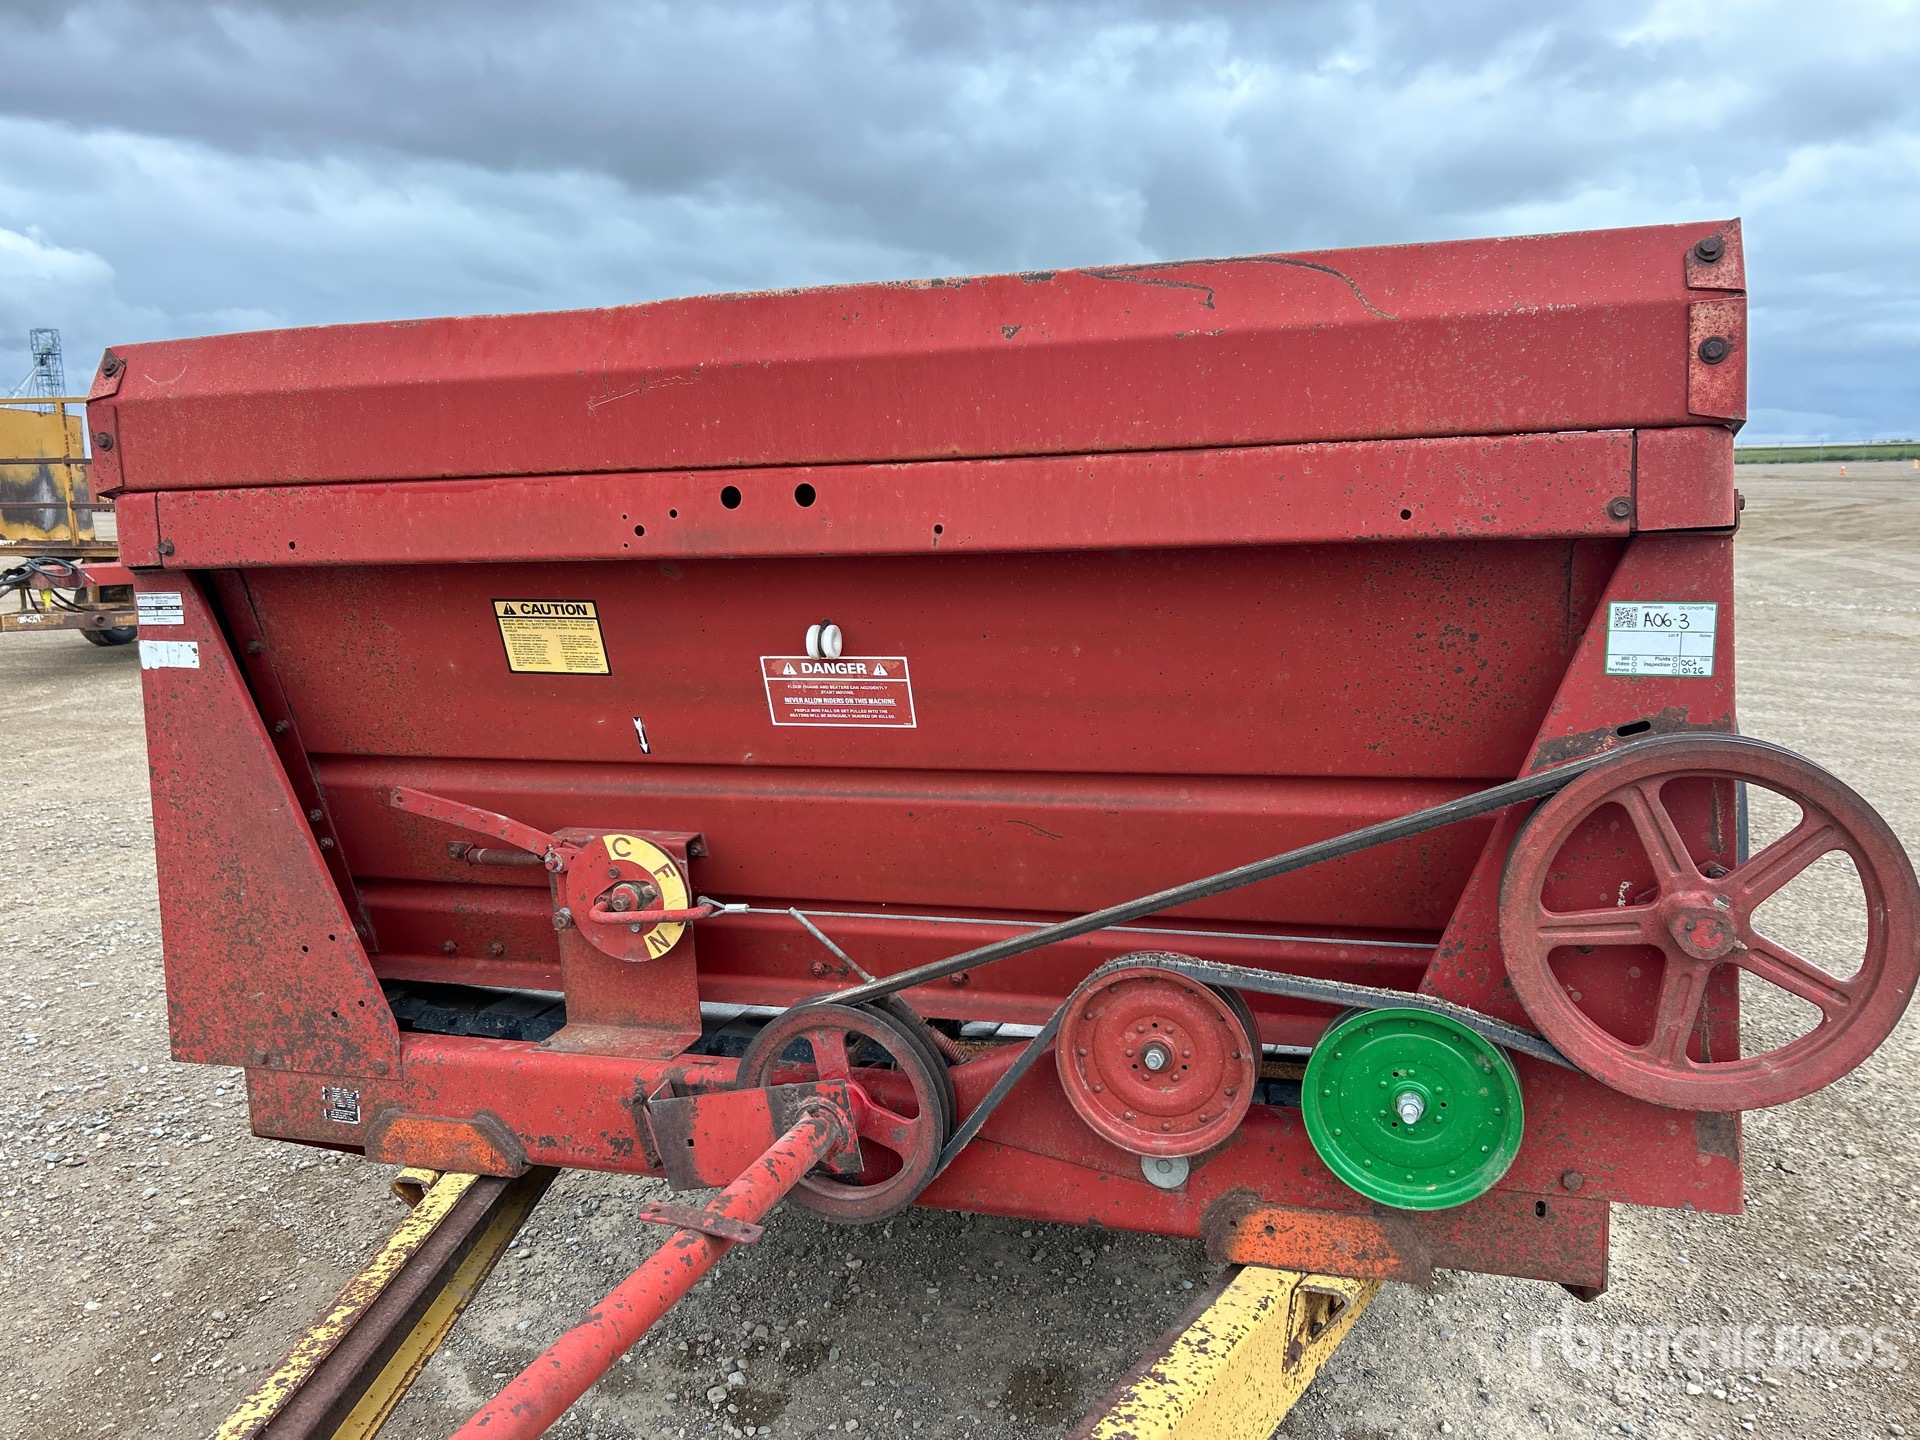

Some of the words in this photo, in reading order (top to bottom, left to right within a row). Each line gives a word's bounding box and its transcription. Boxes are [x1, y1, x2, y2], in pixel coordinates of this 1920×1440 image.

[520, 603, 588, 616] CAUTION
[1644, 612, 1690, 630] A06-3
[801, 662, 867, 674] DANGER
[612, 837, 632, 857] C
[654, 863, 676, 879] F
[648, 930, 671, 954] N
